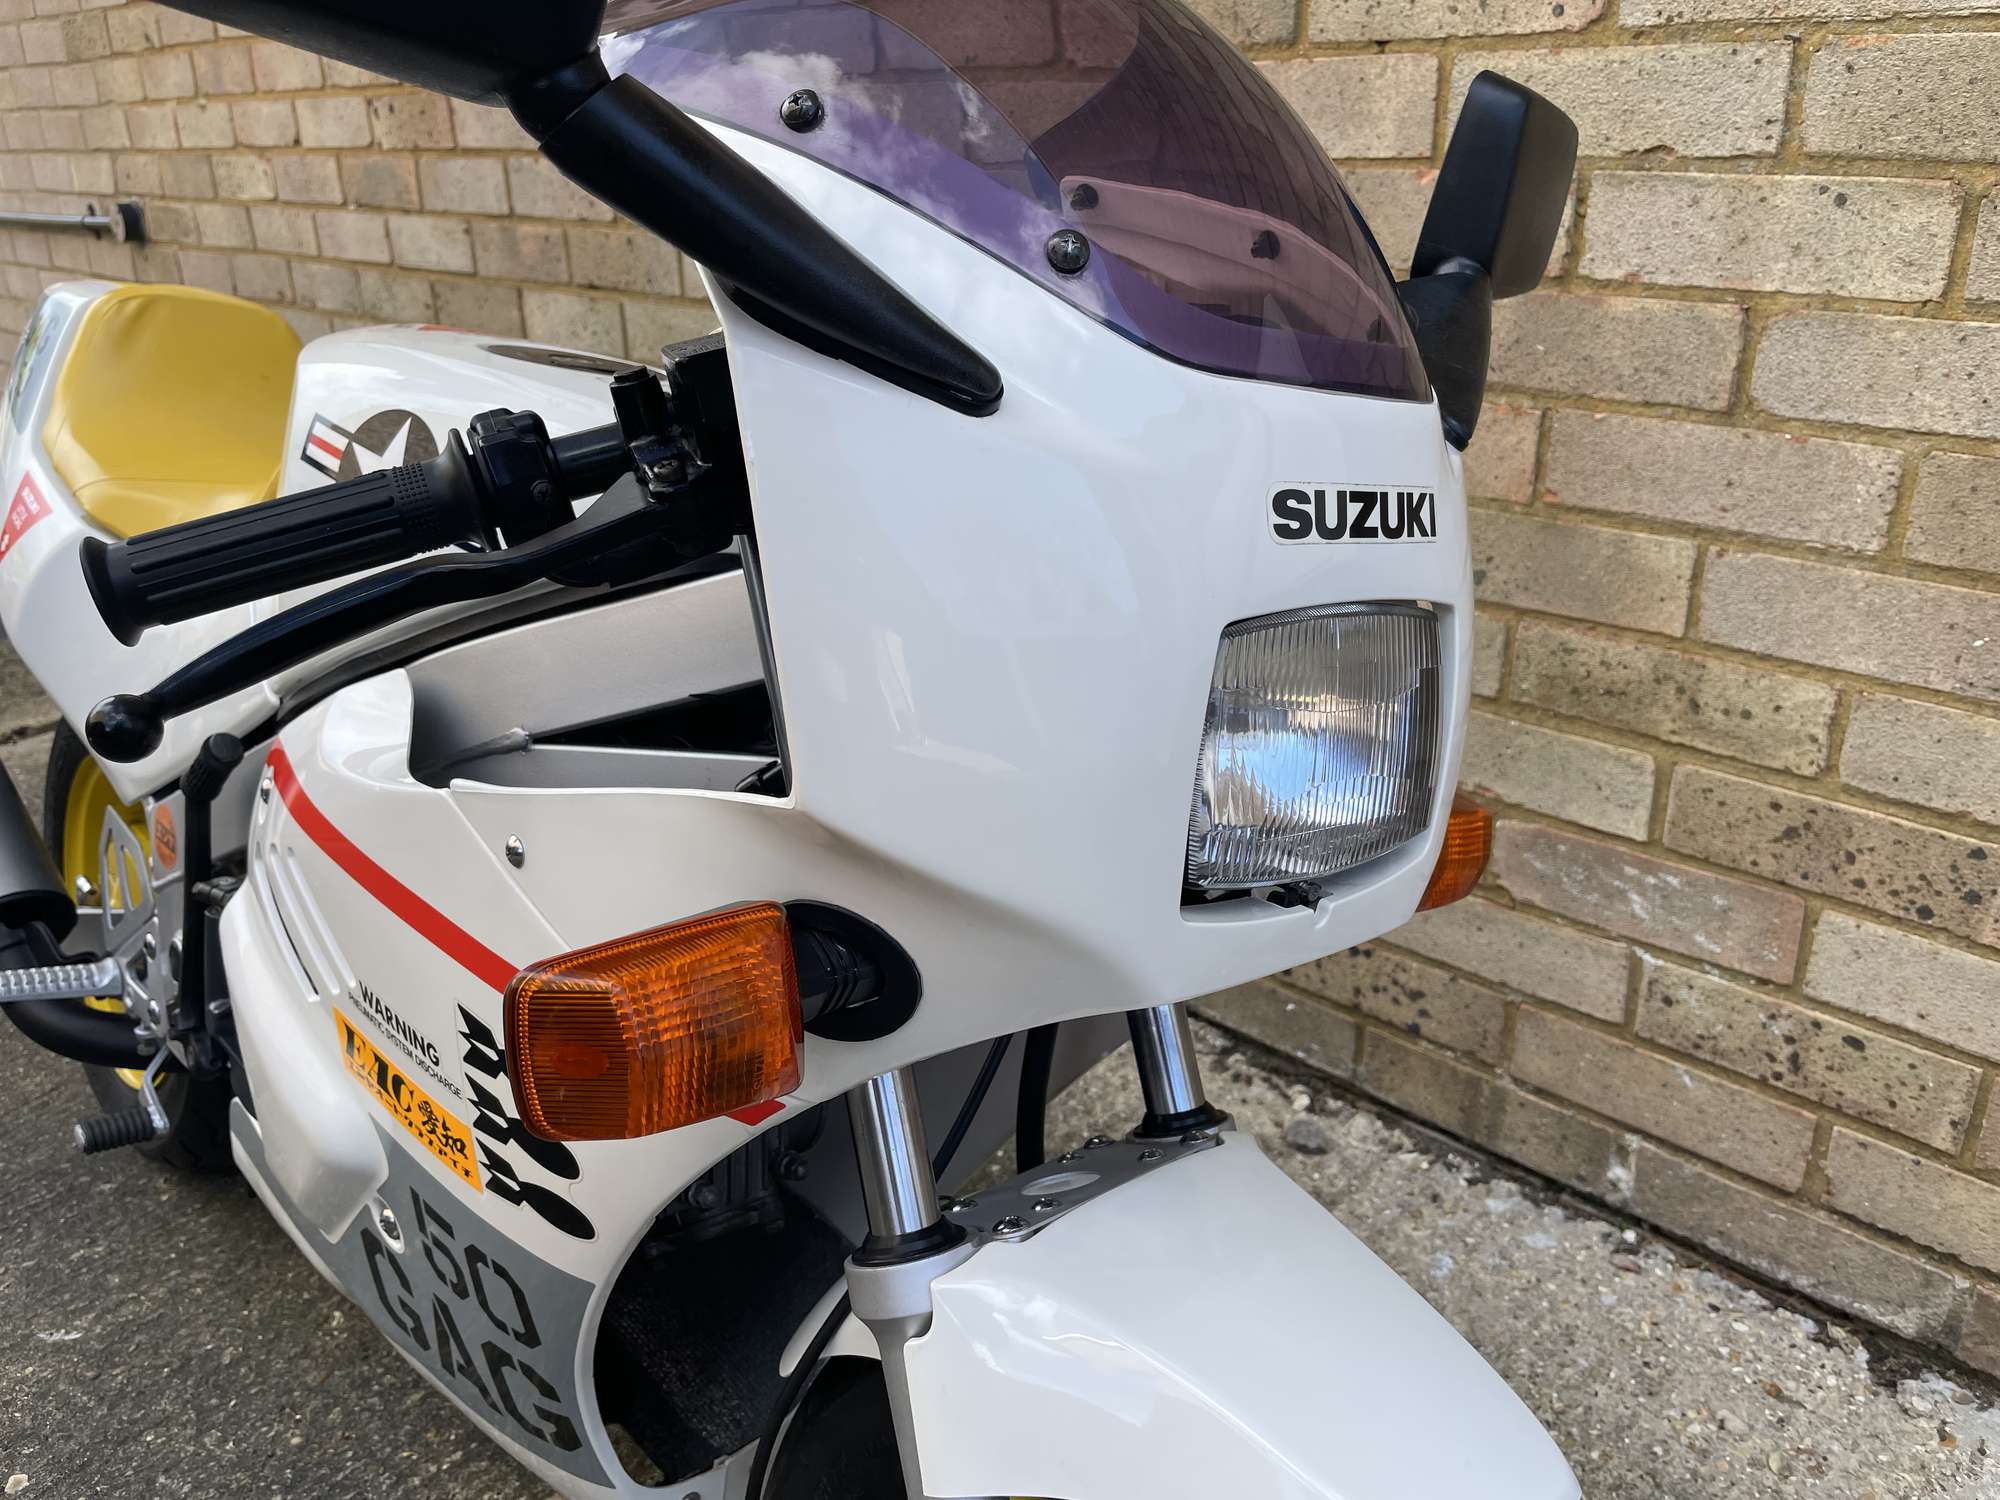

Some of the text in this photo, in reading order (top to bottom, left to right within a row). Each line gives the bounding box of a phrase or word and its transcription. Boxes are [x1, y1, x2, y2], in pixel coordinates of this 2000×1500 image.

[1272, 489, 1437, 541] SUZUKI
[358, 979, 440, 1068] WARNING
[386, 1027, 414, 1061] SYSTEM
[415, 1055, 463, 1100] DISCHARGE
[409, 1185, 542, 1350] 50
[360, 1226, 583, 1453] GAG
